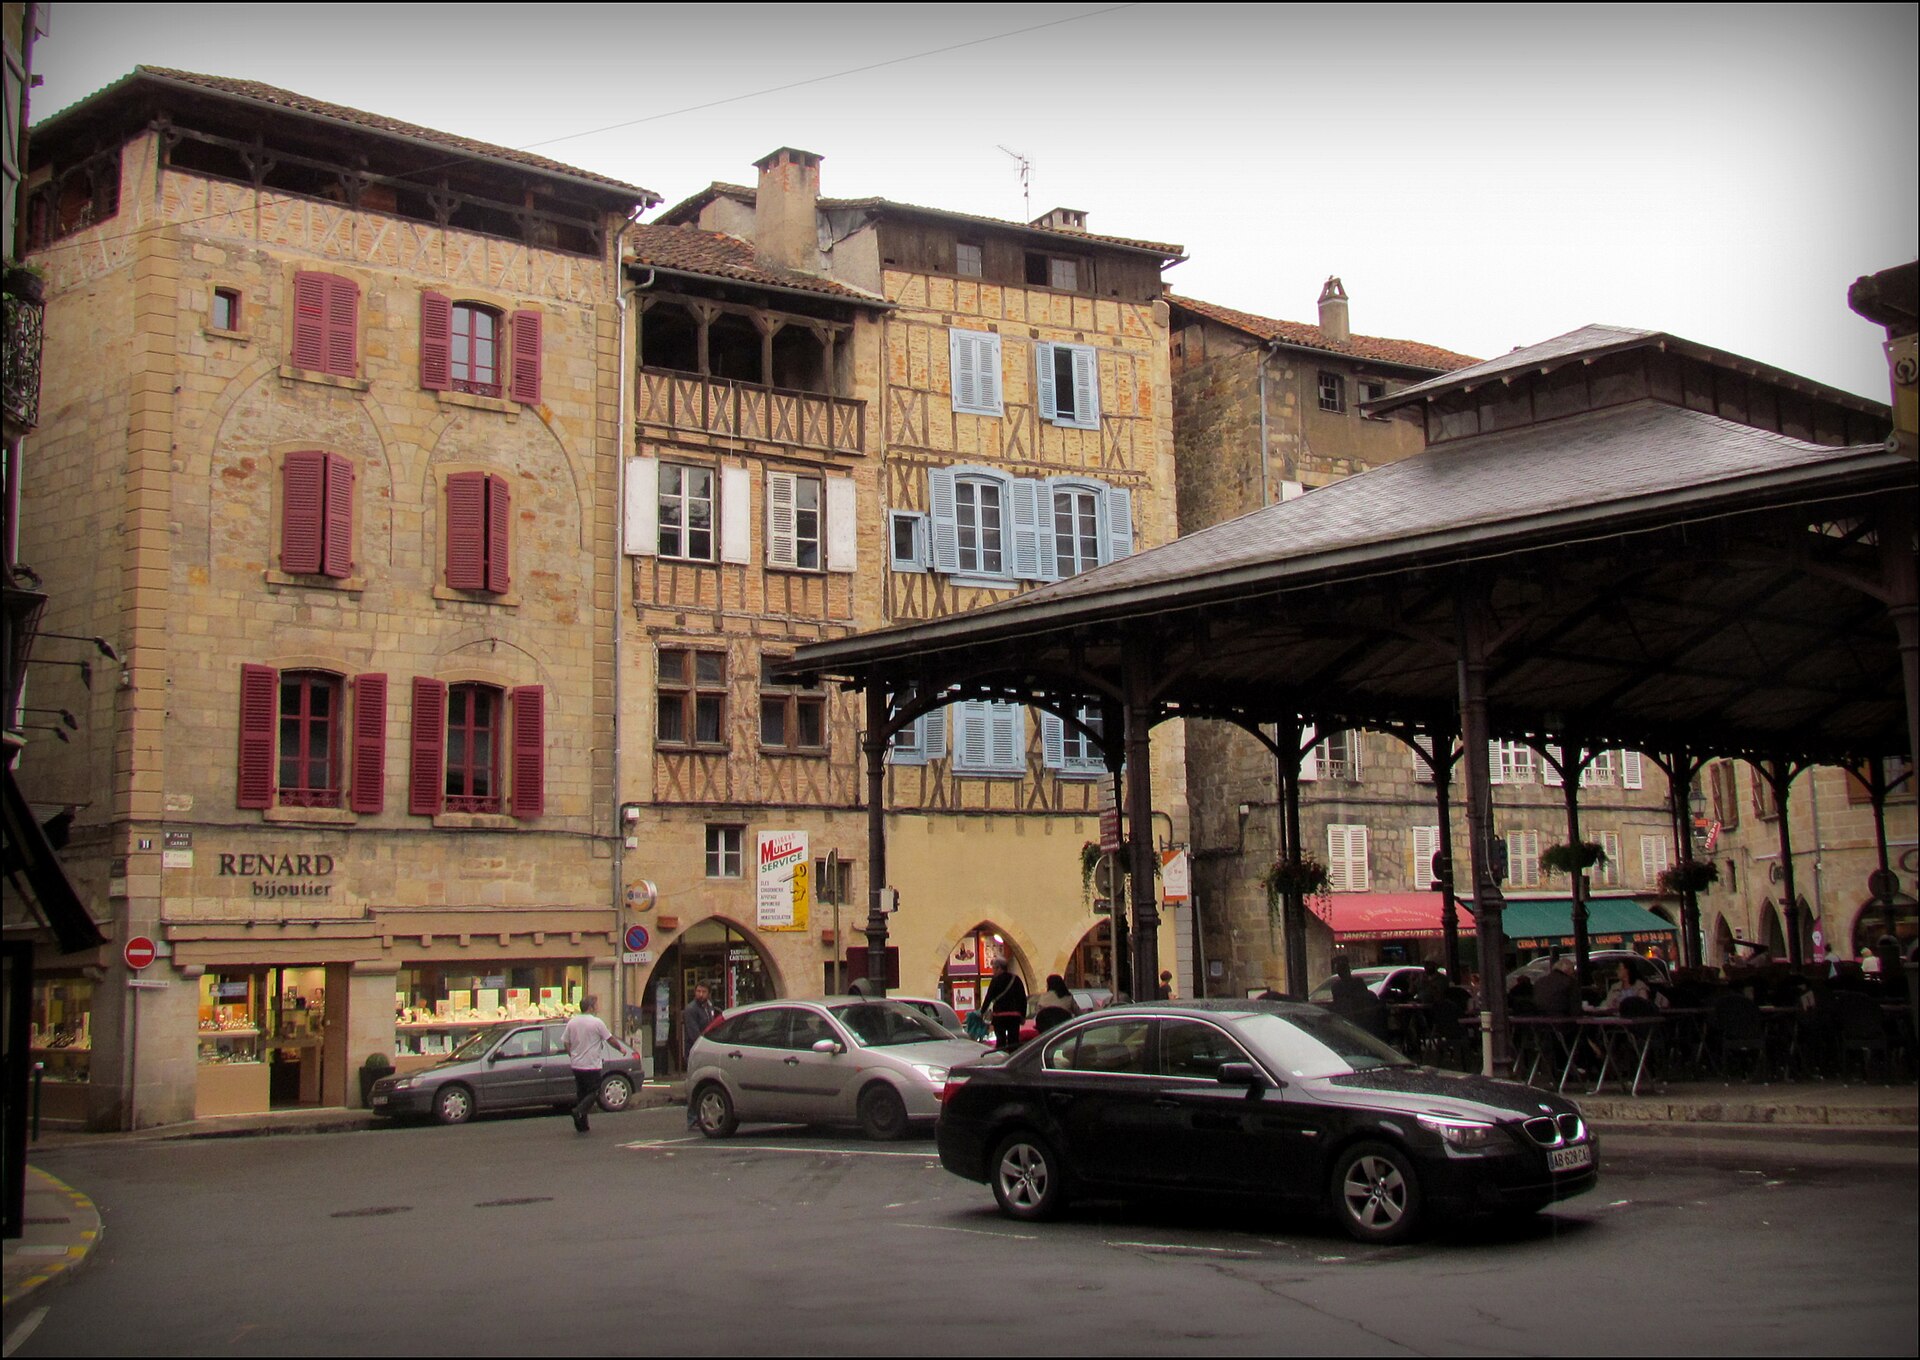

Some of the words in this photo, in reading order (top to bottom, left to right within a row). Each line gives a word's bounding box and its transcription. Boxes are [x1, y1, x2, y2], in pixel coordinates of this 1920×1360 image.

[761, 840, 792, 864] MULTI
[761, 852, 803, 873] SERVICE
[219, 854, 335, 876] RENARD
[252, 881, 332, 898] bijoutier
[1381, 930, 1434, 938] CHARCUTIER
